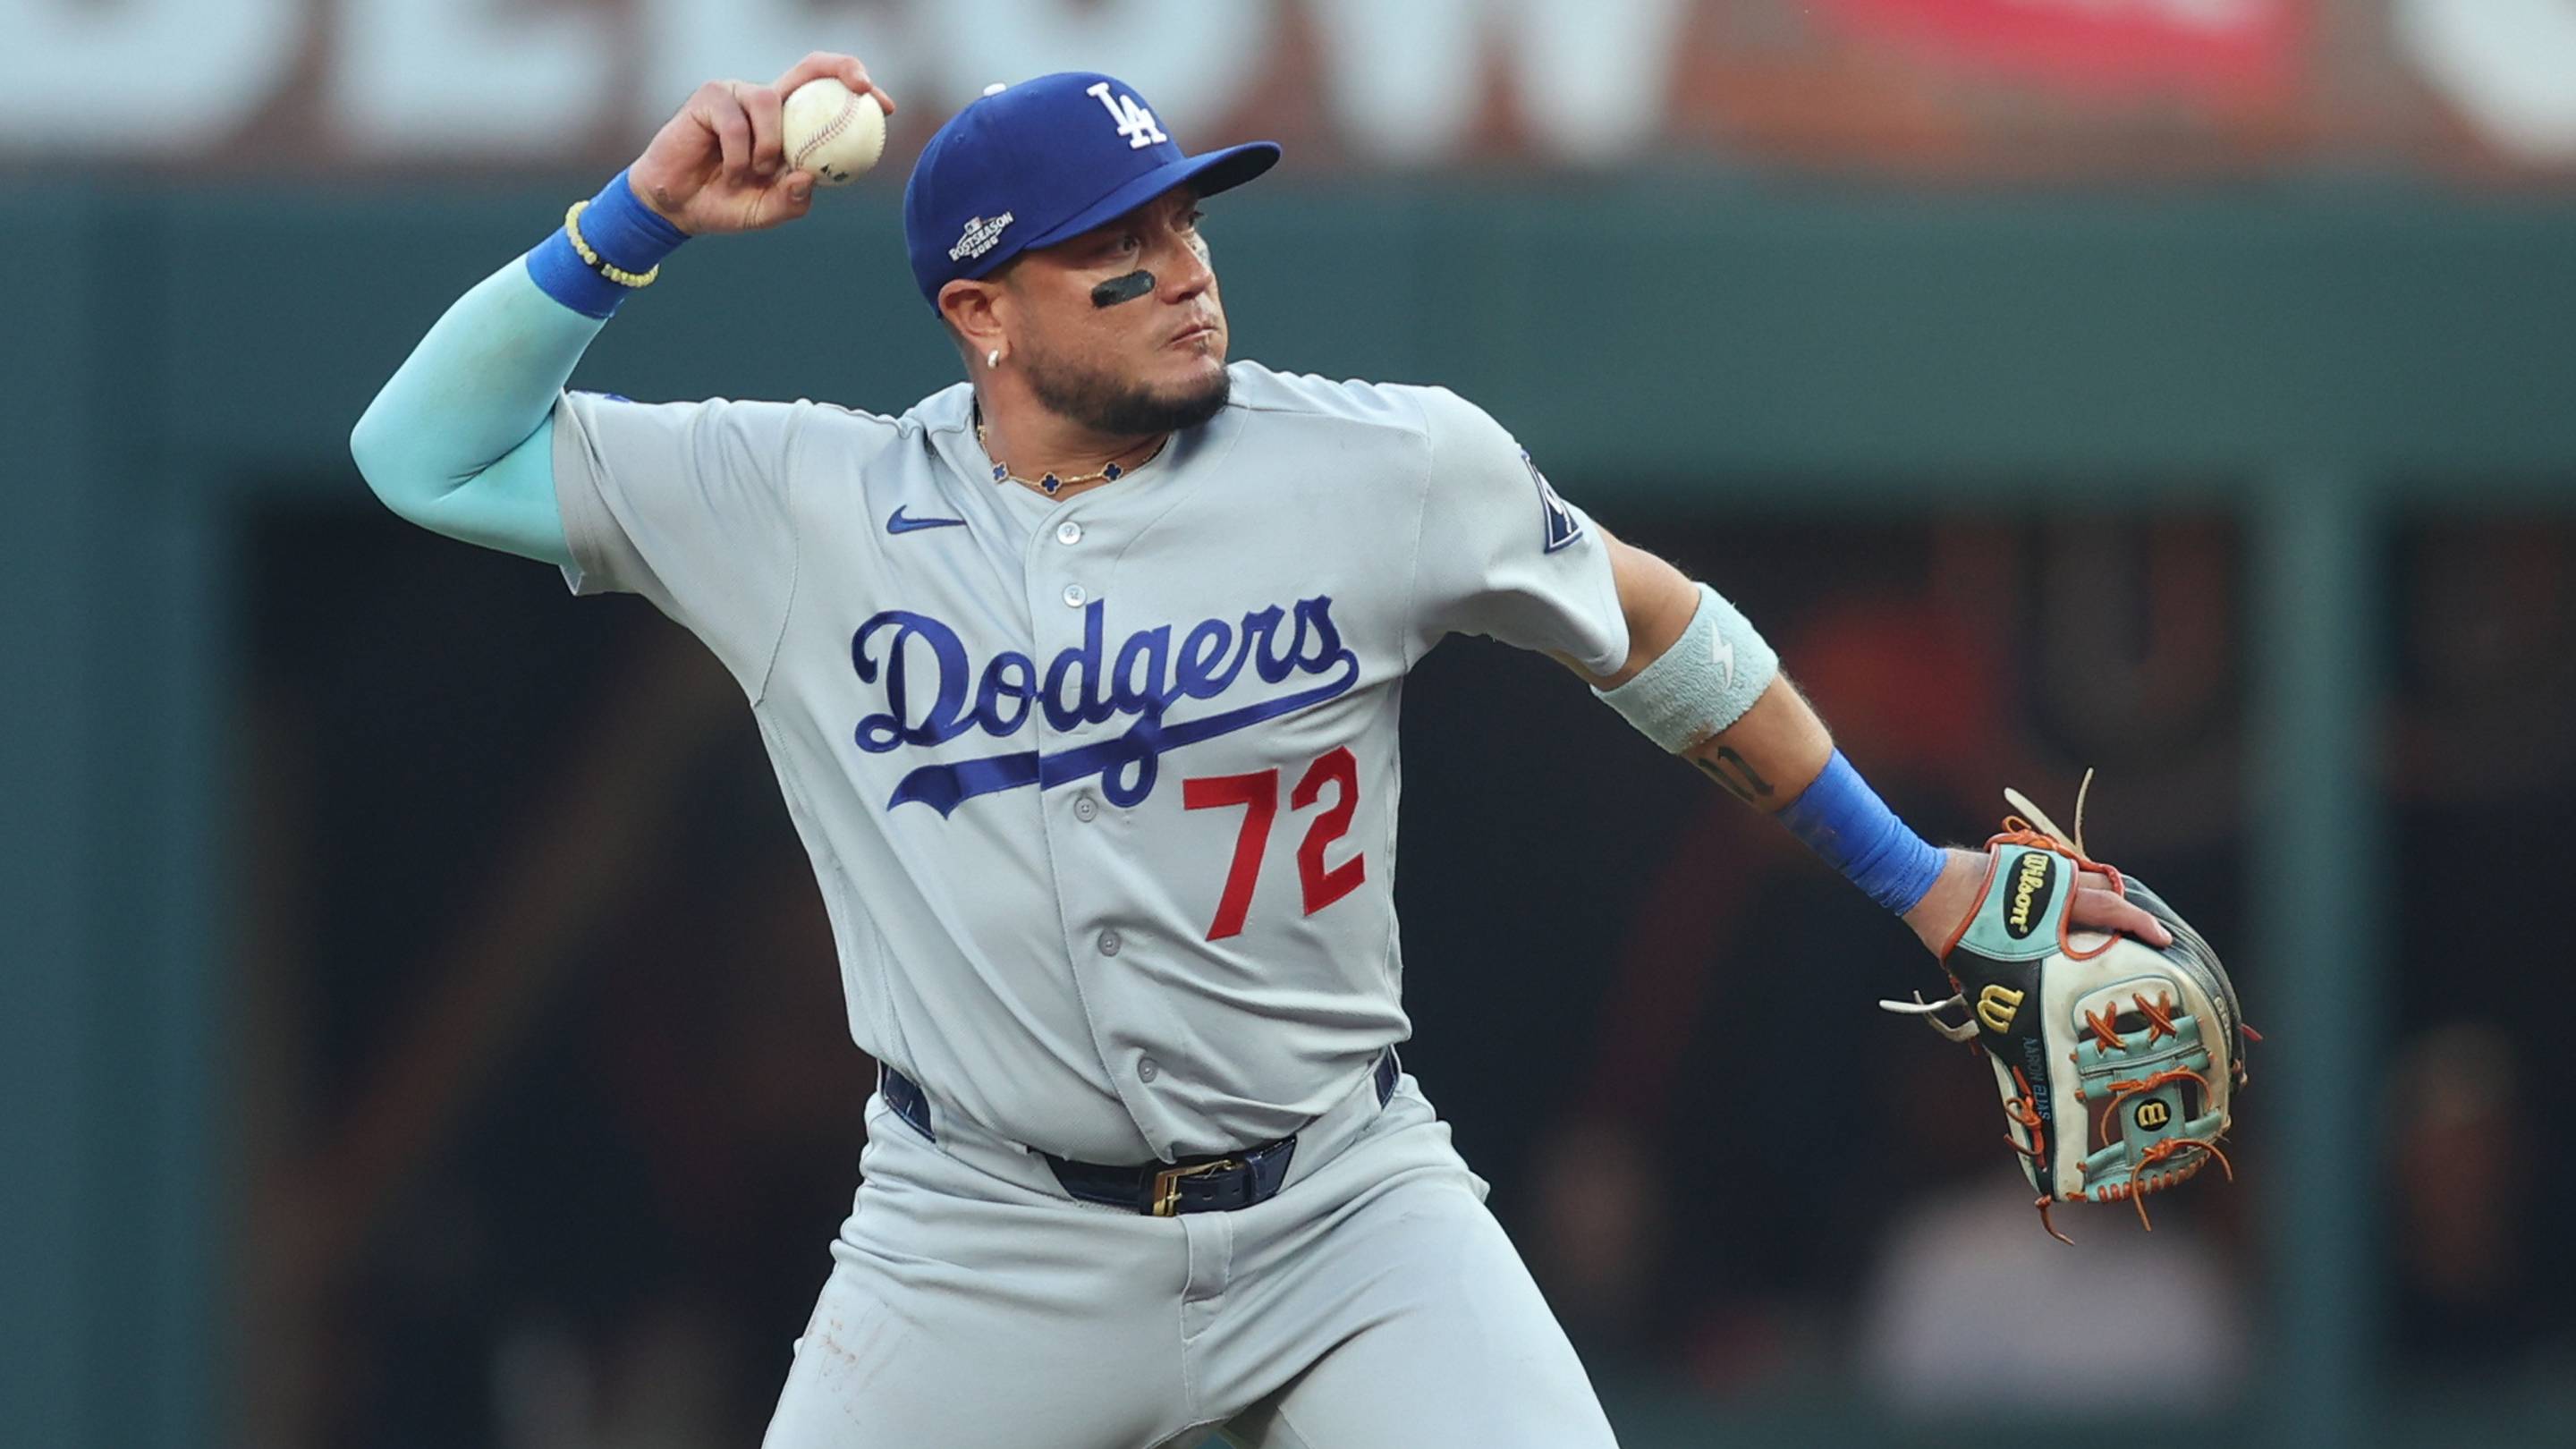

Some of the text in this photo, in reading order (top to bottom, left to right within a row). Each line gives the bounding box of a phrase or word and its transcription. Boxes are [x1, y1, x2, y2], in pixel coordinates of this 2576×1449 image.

[1085, 81, 1167, 149] LA
[948, 211, 1013, 262] POSTSEASON
[852, 595, 1359, 808] Dodgers
[1182, 744, 1365, 942] 72
[2010, 853, 2049, 927] Wilson
